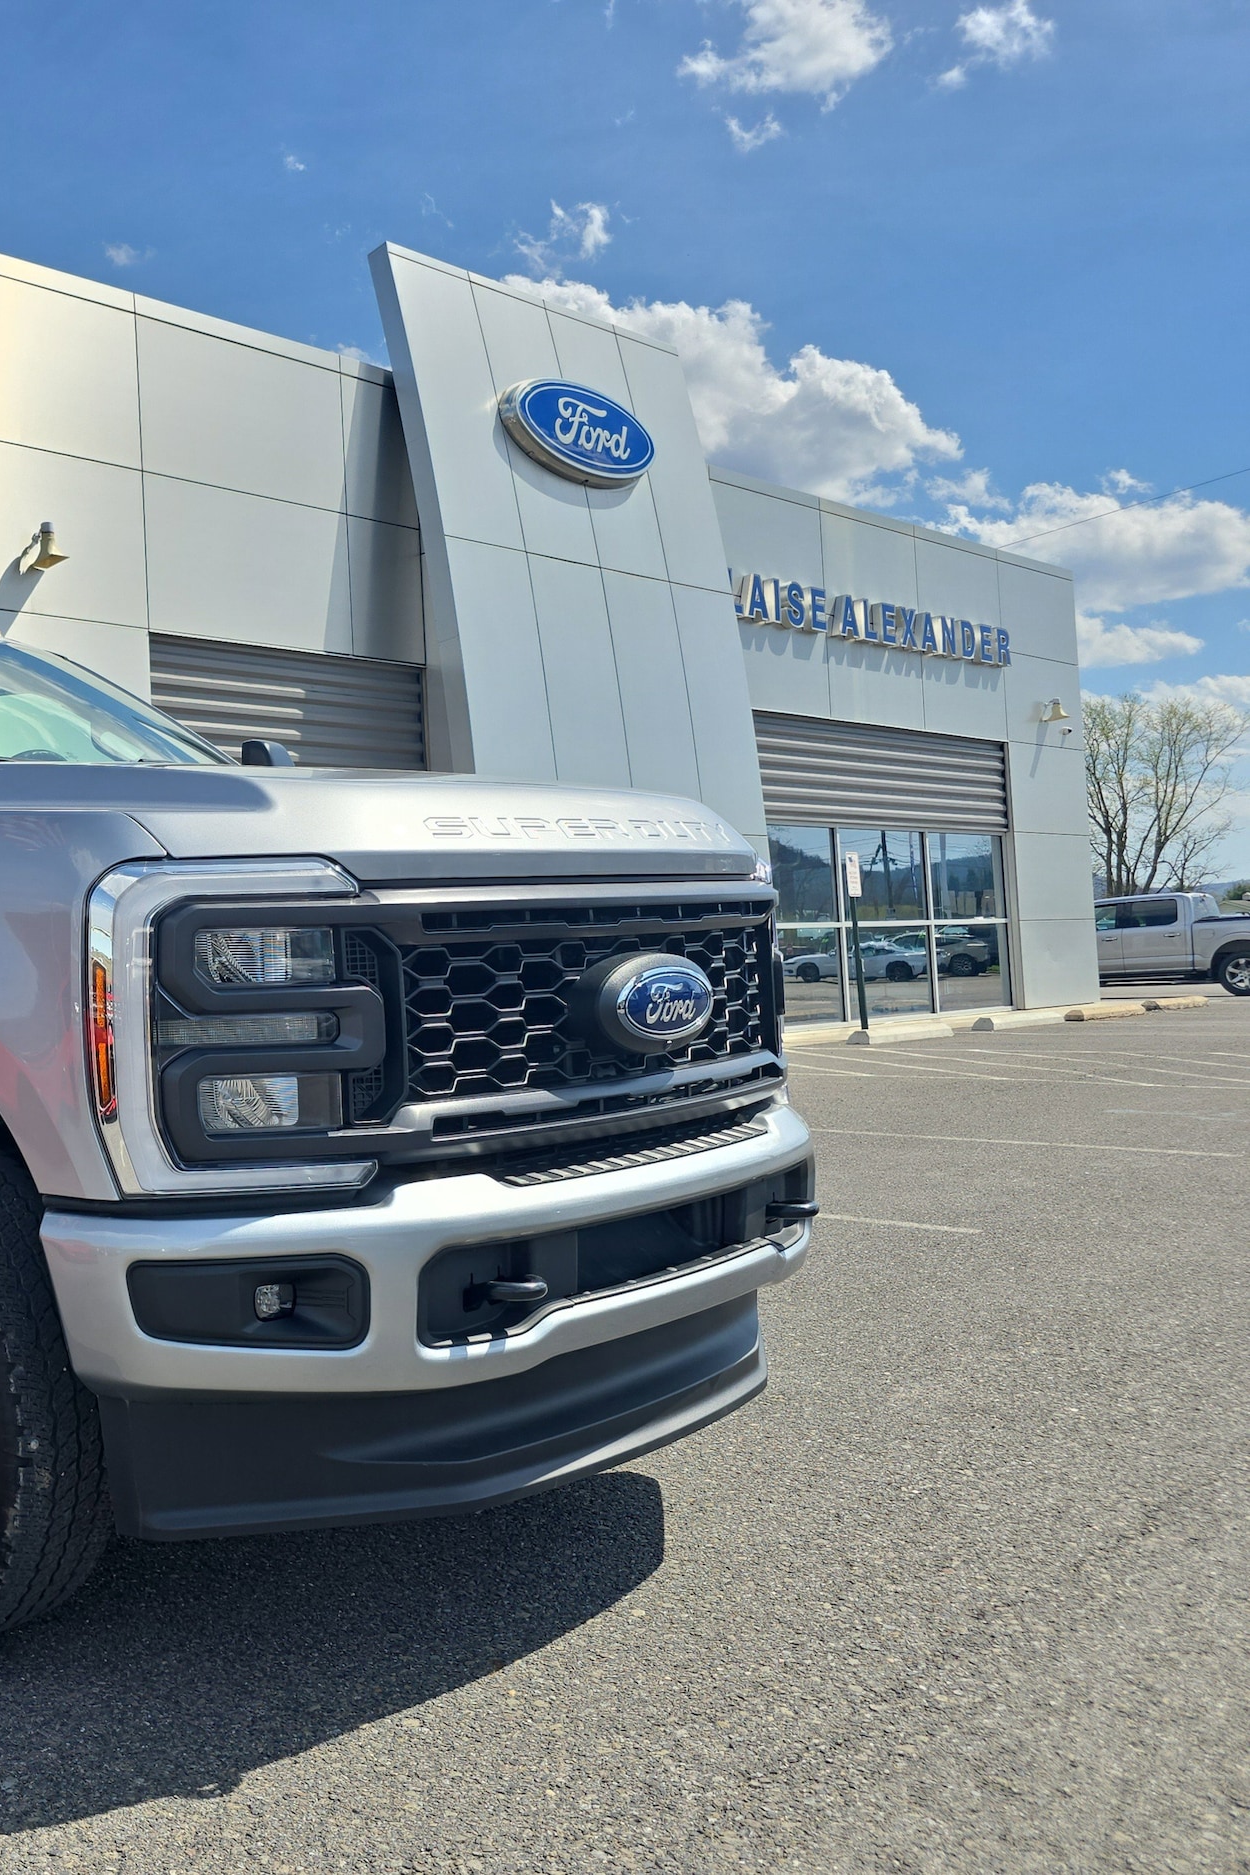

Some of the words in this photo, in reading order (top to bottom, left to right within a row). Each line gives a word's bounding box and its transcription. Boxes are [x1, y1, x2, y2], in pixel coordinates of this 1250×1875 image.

[554, 396, 631, 460] Ford
[832, 594, 1012, 666] ALEXANDER
[423, 816, 634, 841] SUPER
[645, 982, 697, 1025] Ford
